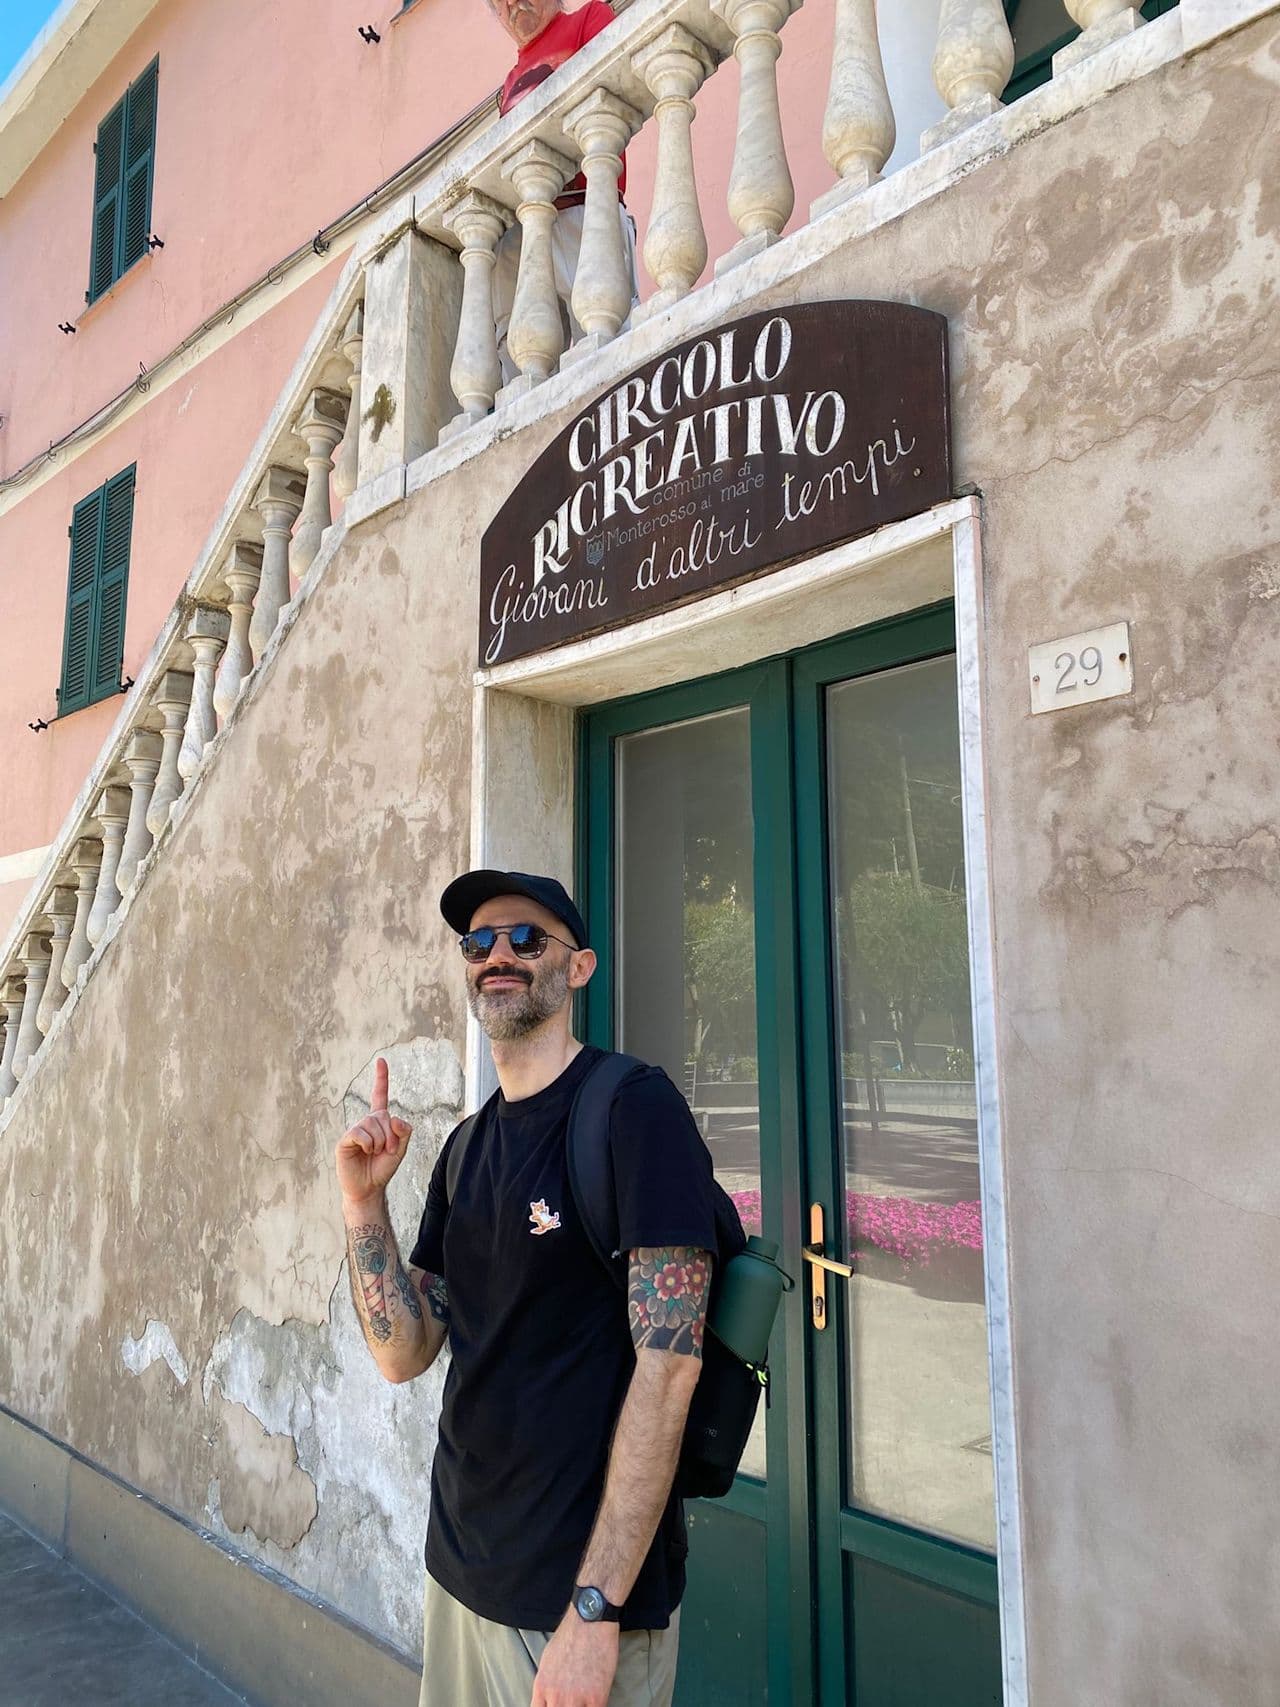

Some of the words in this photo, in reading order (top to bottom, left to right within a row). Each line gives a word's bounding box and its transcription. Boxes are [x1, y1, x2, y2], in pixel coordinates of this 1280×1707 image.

[568, 317, 792, 472] CIRCOLO
[485, 564, 608, 664] Giovani
[631, 509, 762, 592] d'altri
[775, 418, 916, 530] tempi
[531, 390, 846, 590] RICREATIVO
[606, 501, 697, 551] Monterosso
[721, 473, 765, 502] mare
[652, 468, 723, 506] comune
[737, 462, 752, 478] di
[1054, 646, 1104, 694] 29
